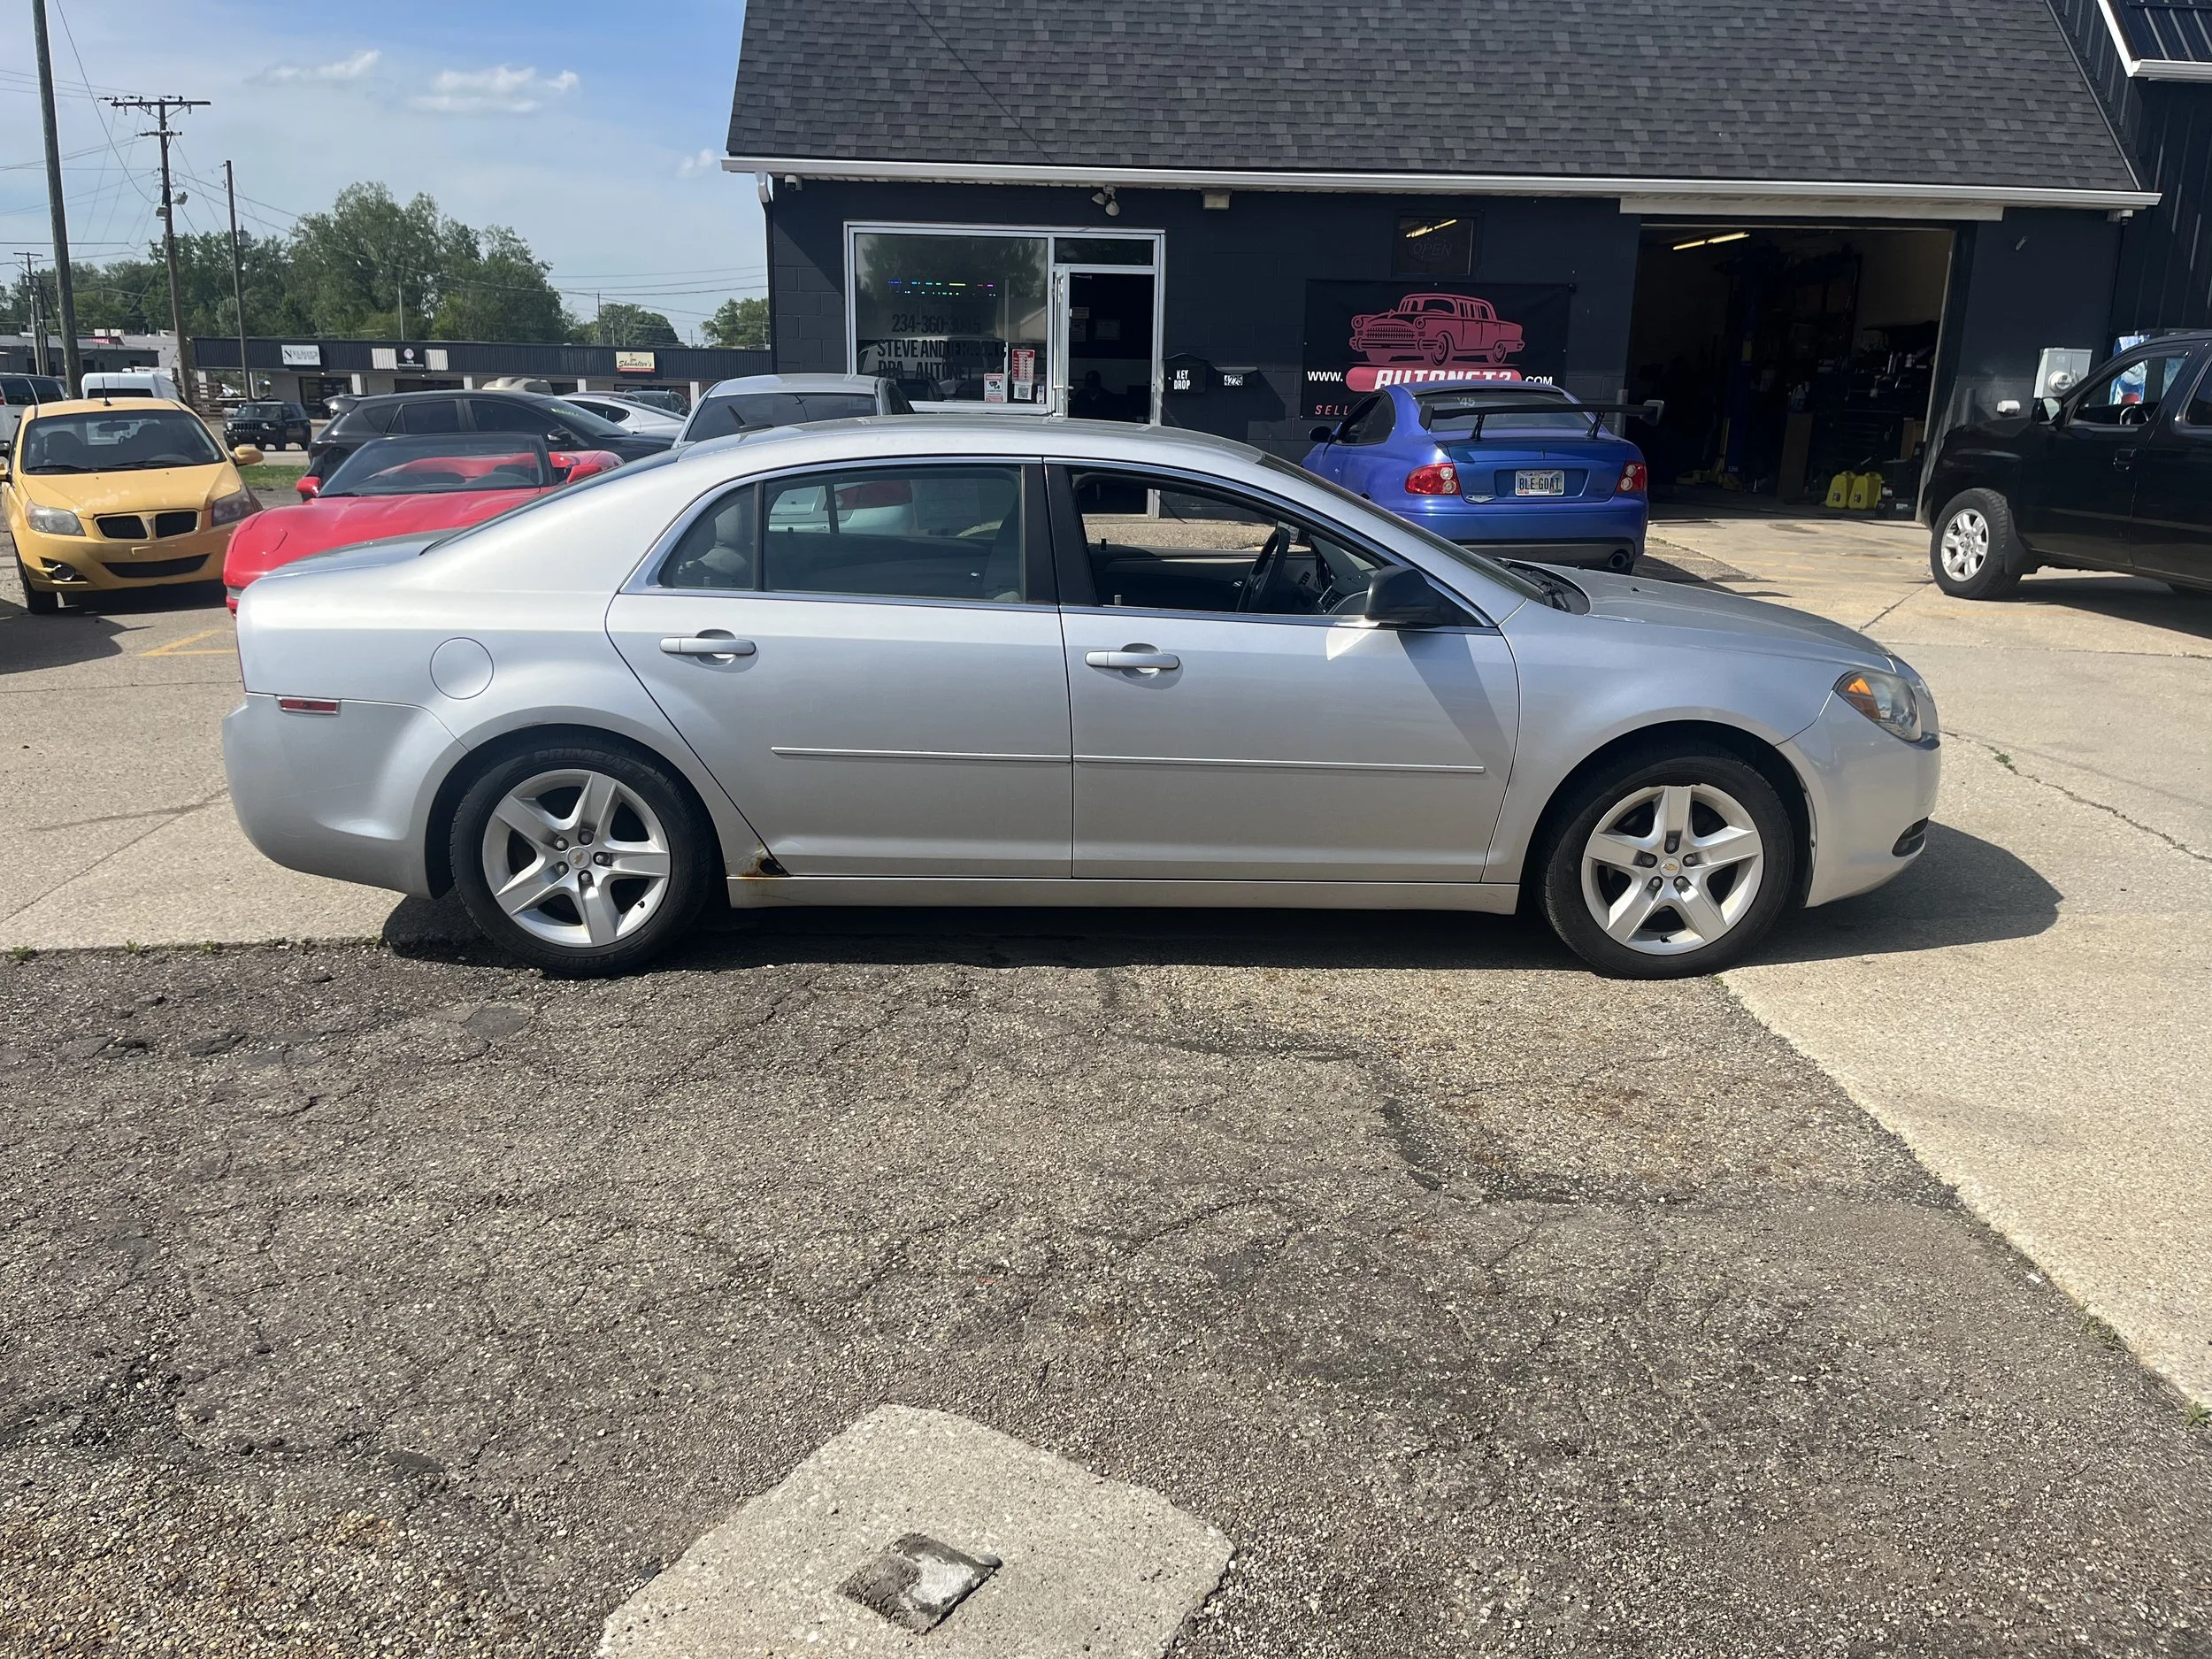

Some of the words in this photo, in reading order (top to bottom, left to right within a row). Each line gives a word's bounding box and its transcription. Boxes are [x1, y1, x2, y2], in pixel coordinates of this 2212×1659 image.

[1413, 242, 1453, 256] OPEN
[877, 339, 918, 357] STEVE
[1176, 369, 1189, 380] KEY
[1307, 371, 1343, 382] WWW.
[1173, 380, 1191, 390] DROP
[1519, 478, 1535, 490] BLE
[1538, 478, 1560, 490] GOAT
